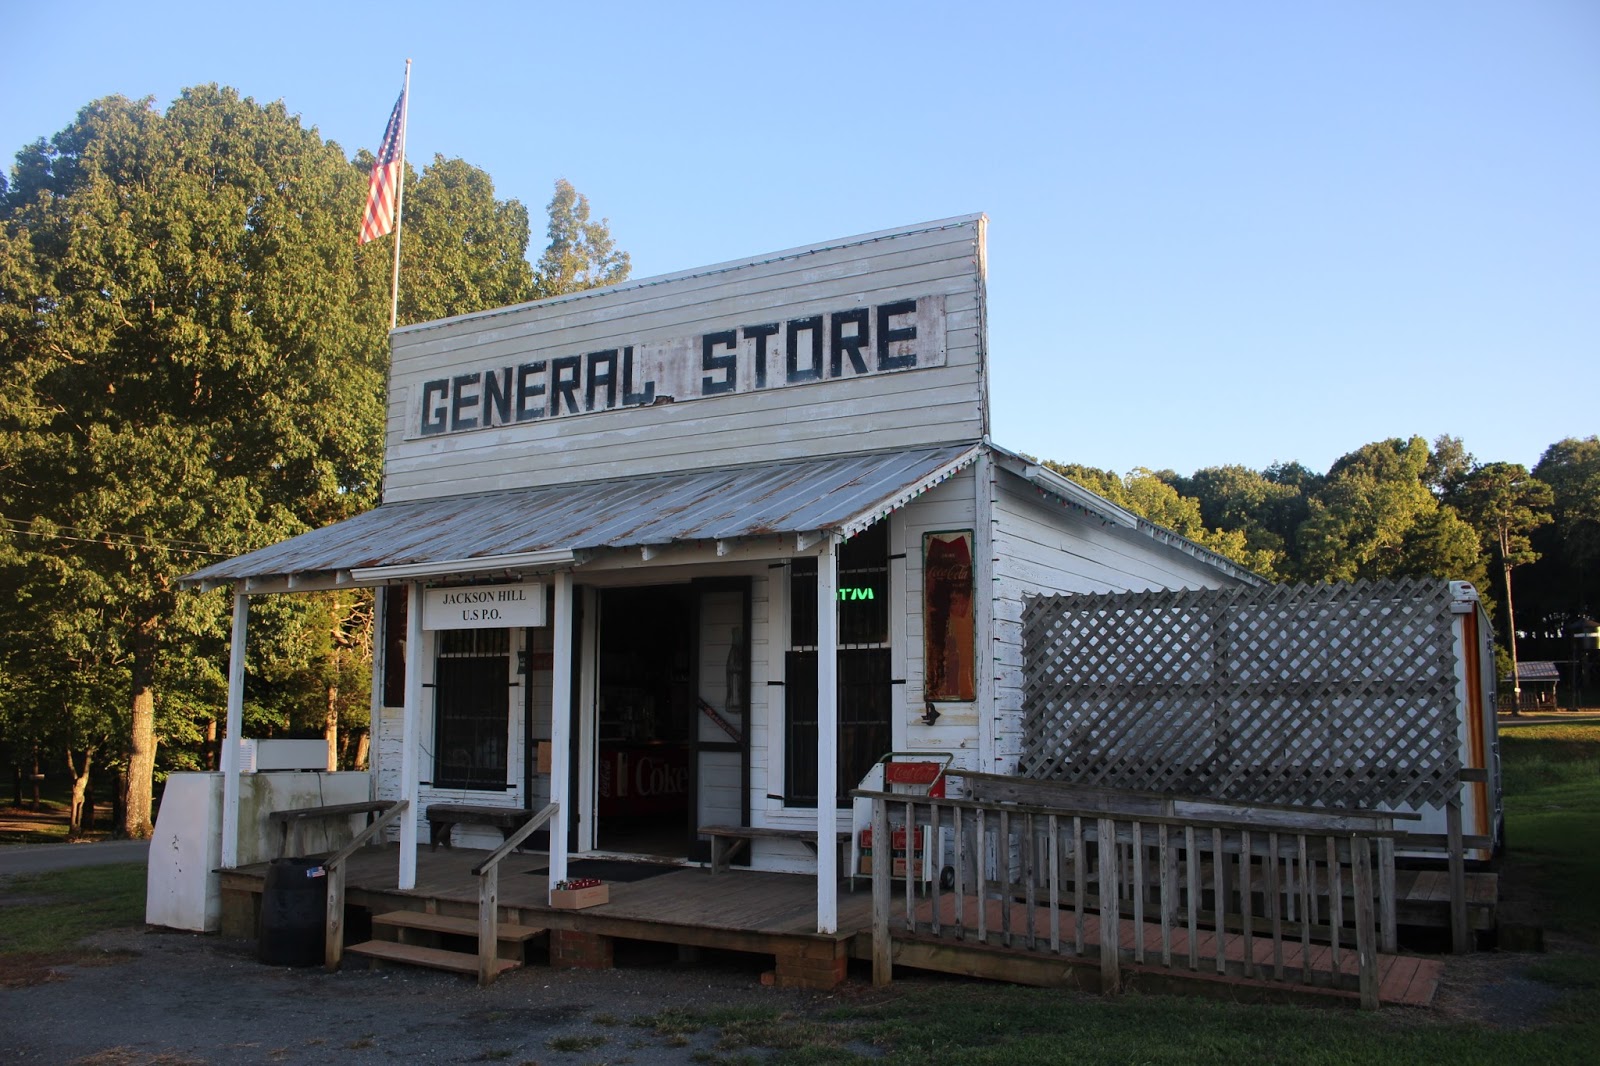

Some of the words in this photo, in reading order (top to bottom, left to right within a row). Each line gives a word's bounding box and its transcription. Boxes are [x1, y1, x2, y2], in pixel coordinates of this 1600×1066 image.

[421, 346, 655, 436] GENERAL
[702, 300, 917, 396] STORE
[443, 591, 495, 605] JACKSON
[498, 590, 526, 602] HILL
[835, 588, 874, 600] TM
[482, 609, 502, 620] P.O.
[635, 756, 688, 797] Coke
